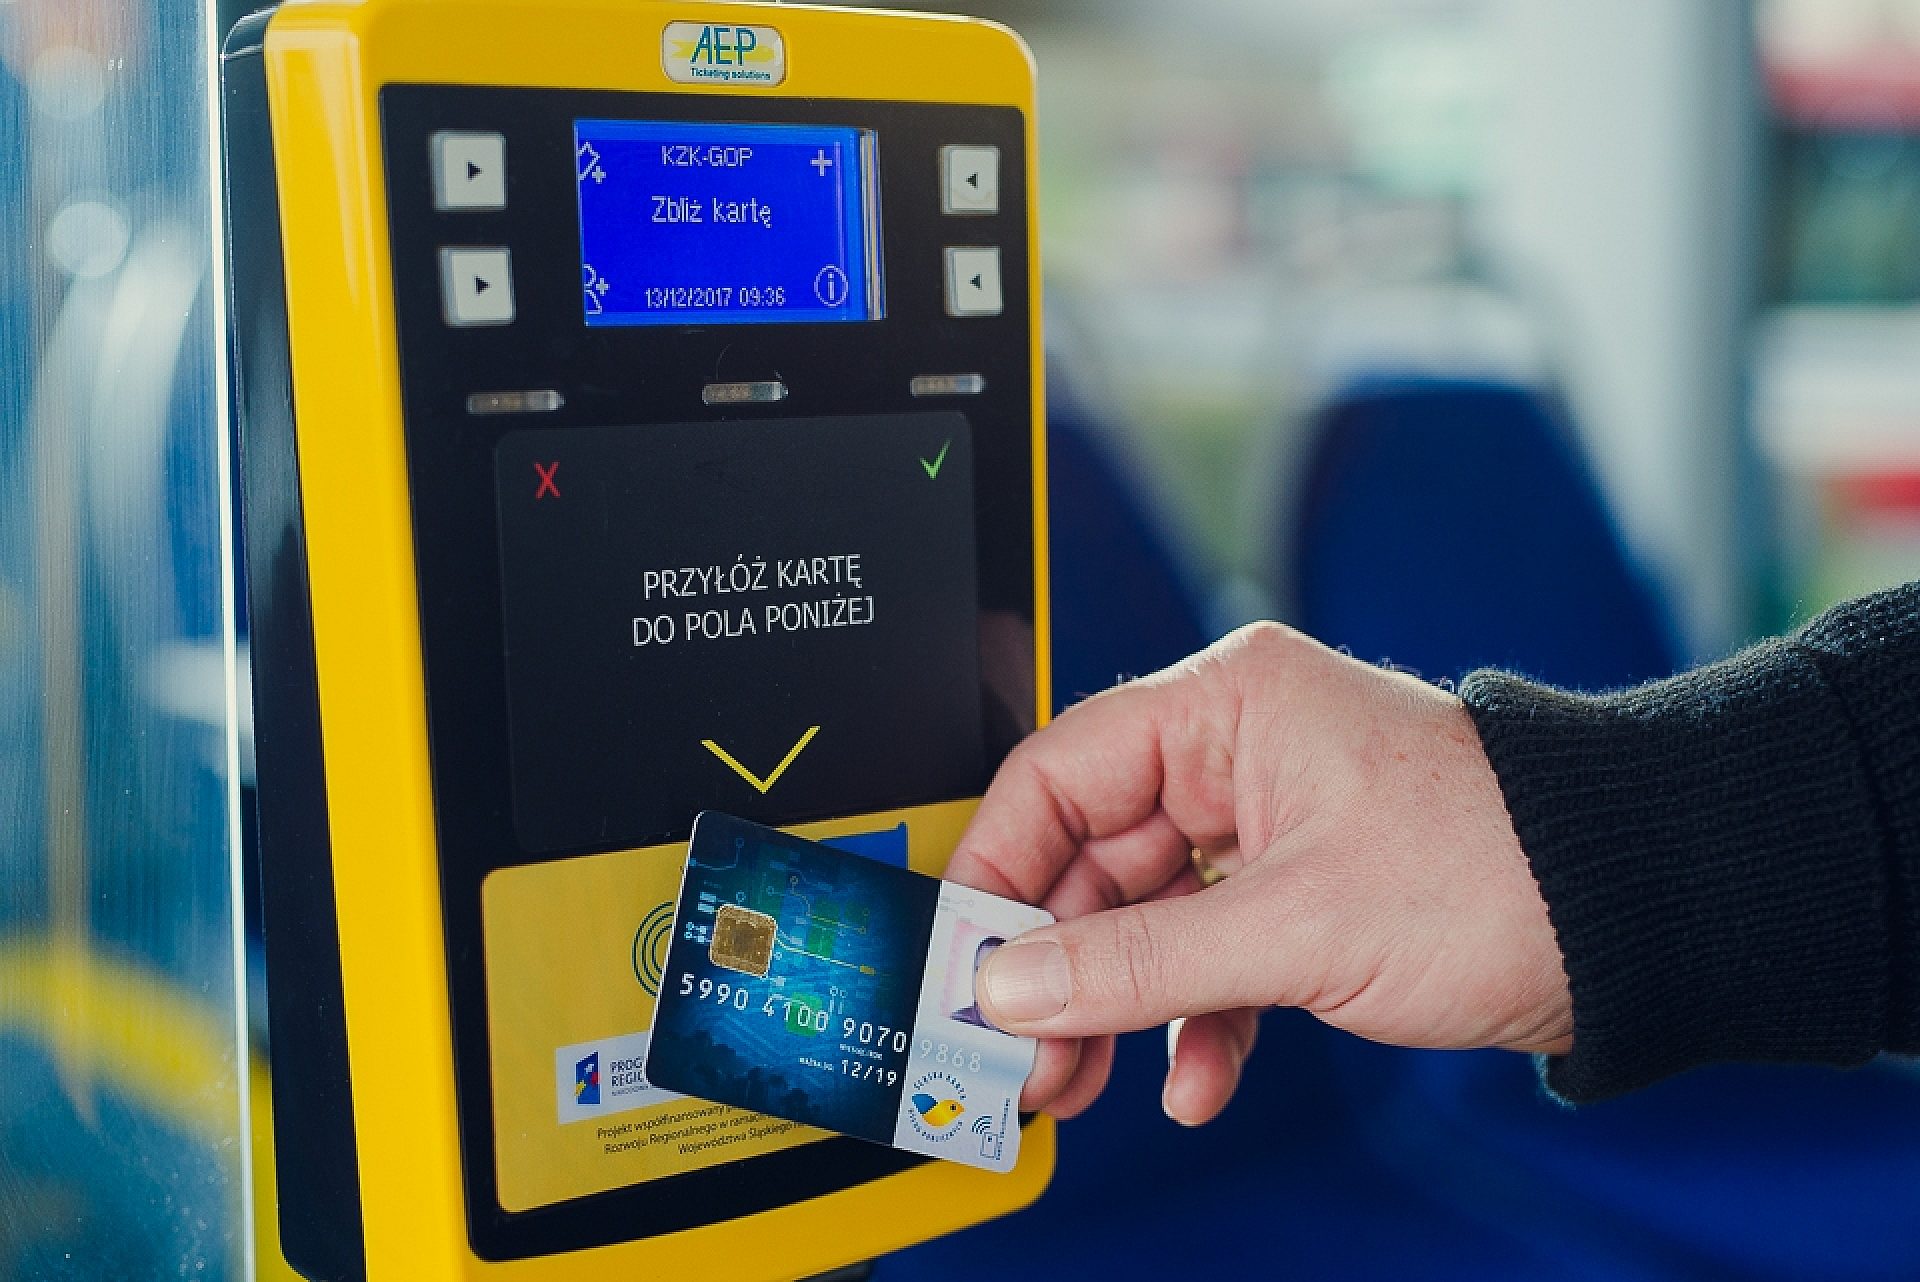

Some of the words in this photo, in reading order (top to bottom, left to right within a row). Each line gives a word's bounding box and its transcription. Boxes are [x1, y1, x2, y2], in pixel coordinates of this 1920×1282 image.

[690, 25, 757, 66] AEP
[690, 67, 730, 81] Ticketing
[732, 69, 771, 81] solutions
[661, 145, 753, 167] KZK-GOP
[651, 195, 703, 223] Zbliż
[713, 197, 772, 228] kartę
[645, 287, 732, 309] 13/12/2017
[739, 286, 786, 307] 09:36
[643, 553, 769, 601] PRZYŁÓŻ
[777, 553, 863, 588] KARTĘ
[632, 613, 675, 647] DO
[685, 607, 757, 641] POLA
[766, 591, 875, 633] PONIŻEJ
[679, 972, 749, 1011] 5990
[762, 994, 829, 1033] 4100
[843, 1017, 907, 1053] 9070
[920, 1038, 982, 1073] 9868
[610, 1055, 644, 1073] PROG
[841, 1059, 897, 1087] 12/19
[597, 1123, 632, 1140] Projekt
[649, 1121, 717, 1144] Regionalnego
